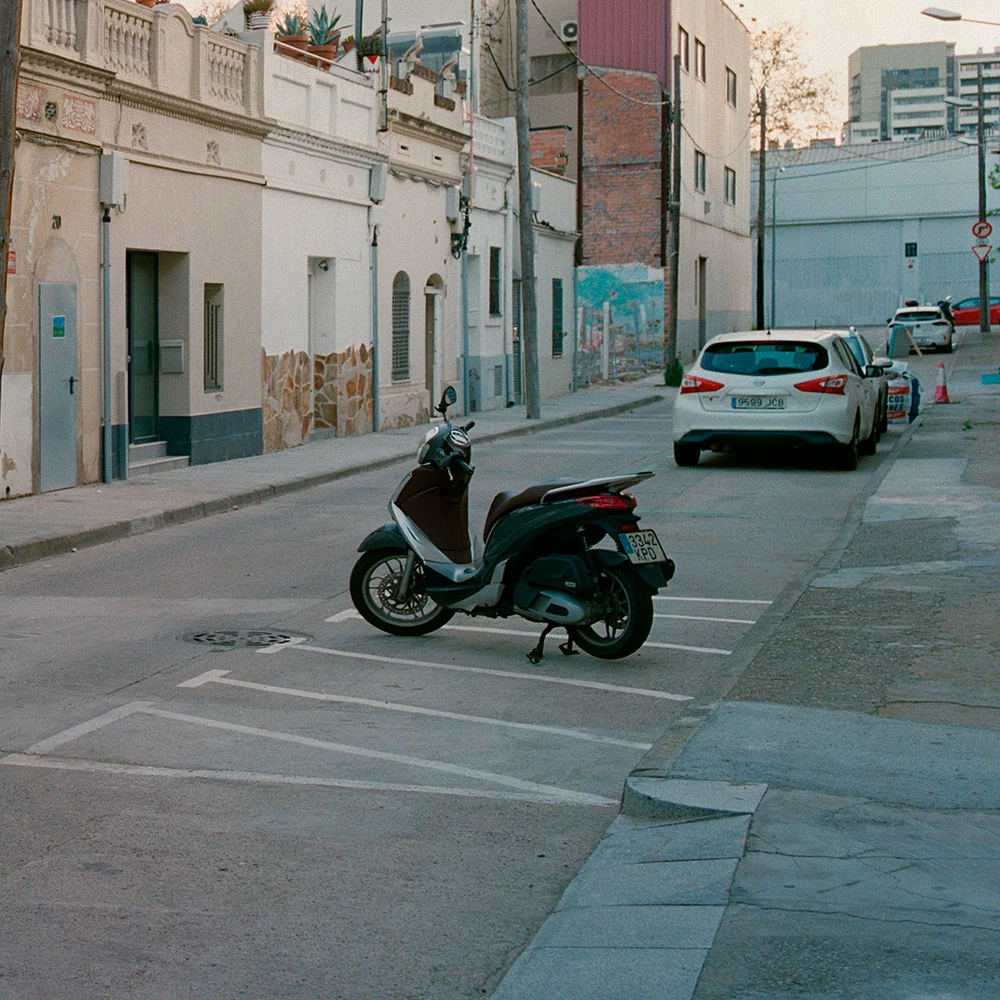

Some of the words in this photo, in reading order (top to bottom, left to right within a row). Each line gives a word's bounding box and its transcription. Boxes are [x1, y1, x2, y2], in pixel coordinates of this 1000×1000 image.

[51, 214, 62, 230] 20
[628, 533, 658, 548] 3342
[634, 547, 657, 561] KPD
